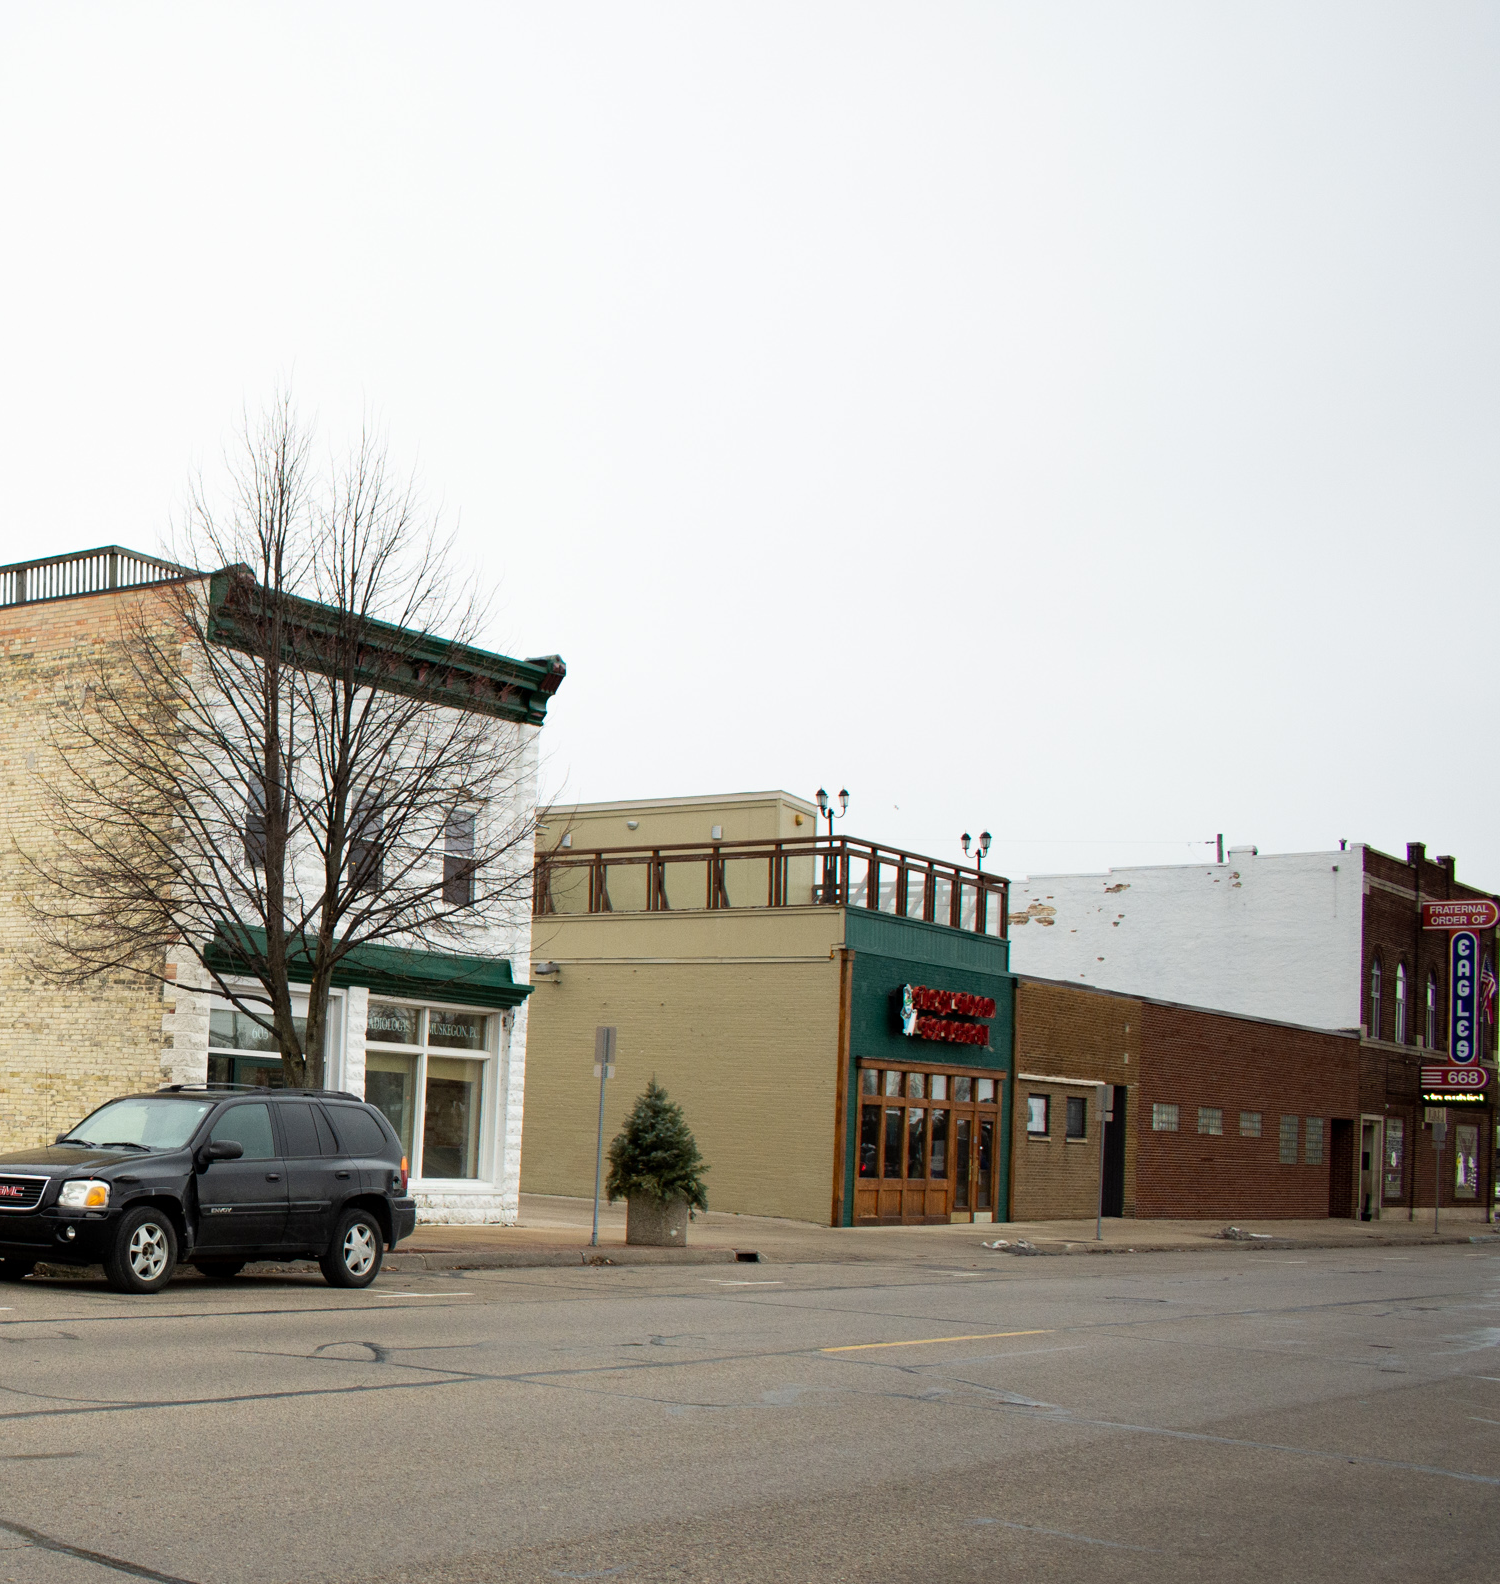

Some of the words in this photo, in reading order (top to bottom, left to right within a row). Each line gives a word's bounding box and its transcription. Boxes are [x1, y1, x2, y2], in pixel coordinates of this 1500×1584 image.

[1430, 905, 1489, 914] FRATERNAL
[1431, 917, 1467, 925] ORDER
[1472, 915, 1487, 924] OF
[1456, 939, 1471, 1057] EAGLES
[367, 1016, 409, 1033] ADIOLOGY
[251, 1026, 269, 1040] 605
[1447, 1071, 1478, 1084] 668
